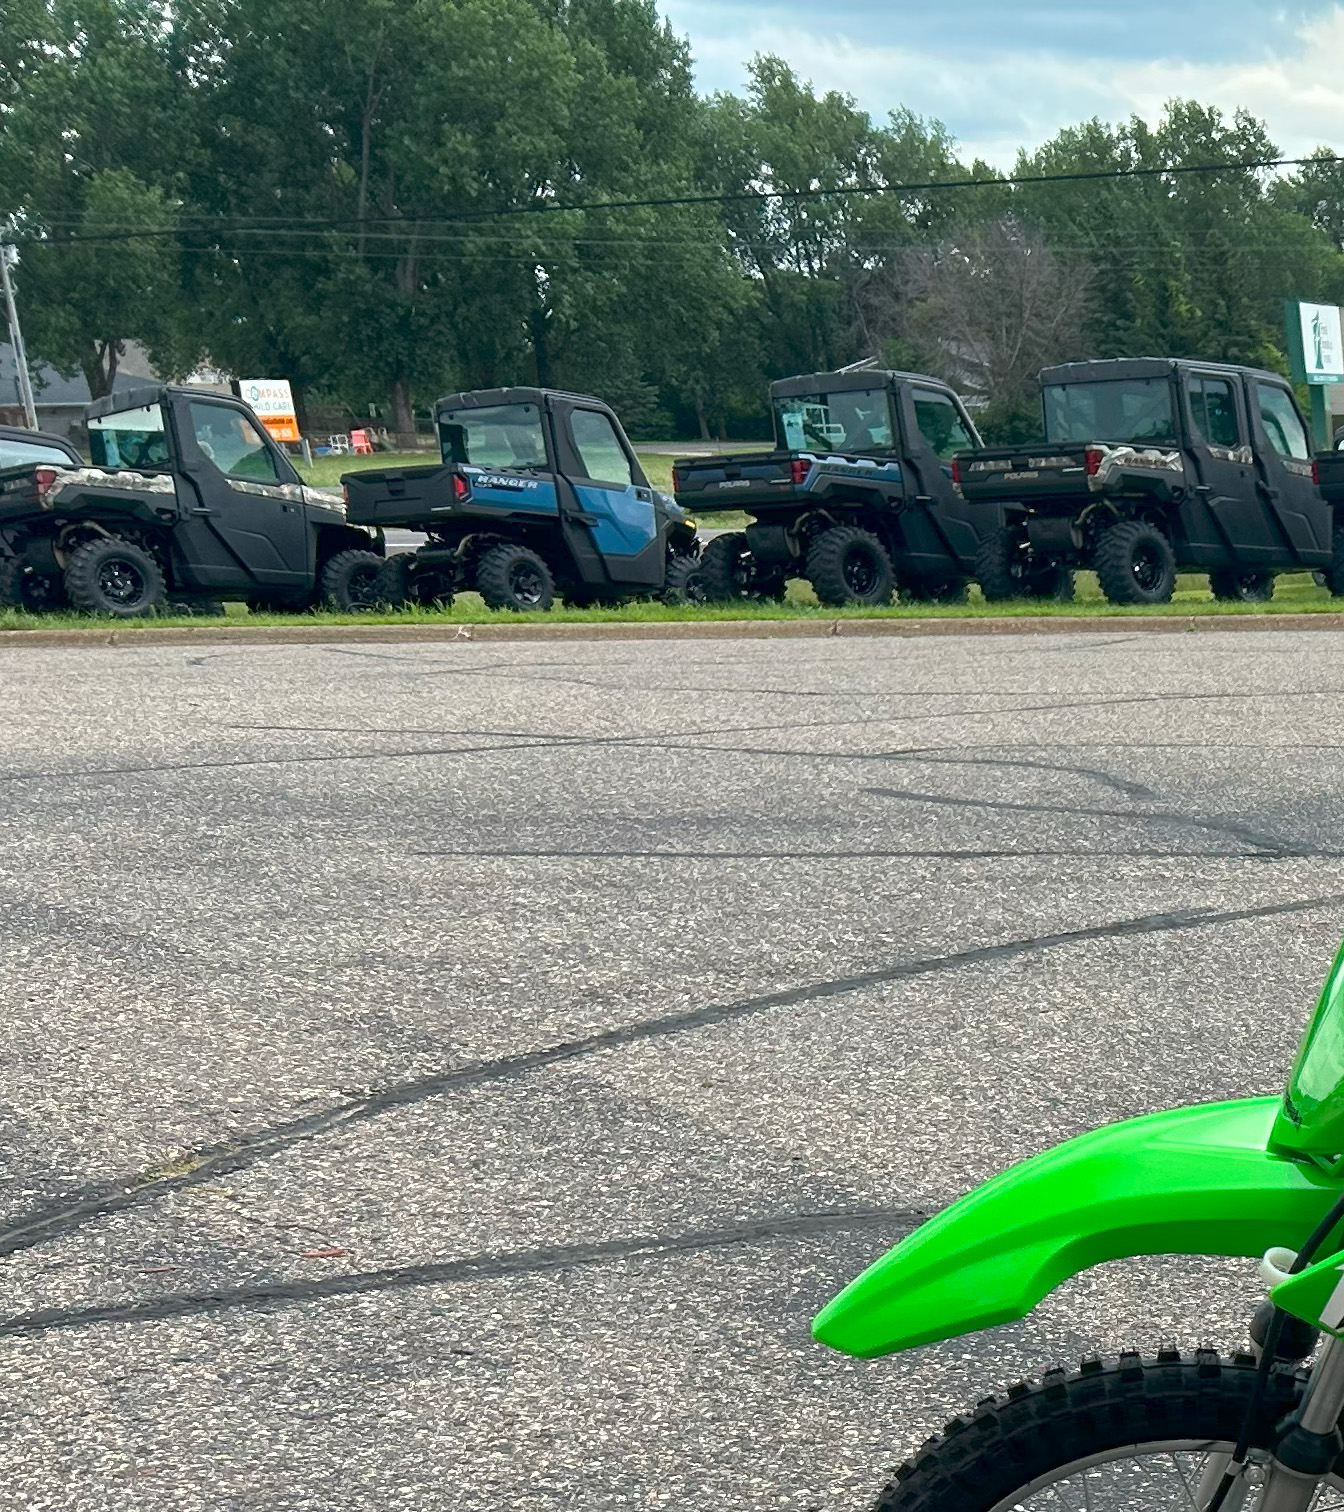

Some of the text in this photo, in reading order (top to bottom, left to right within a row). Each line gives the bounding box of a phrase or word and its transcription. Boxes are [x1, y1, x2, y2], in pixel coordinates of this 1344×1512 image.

[1004, 471, 1039, 480] POLARIS
[477, 475, 538, 489] RANGER
[719, 480, 750, 488] POLARIS
